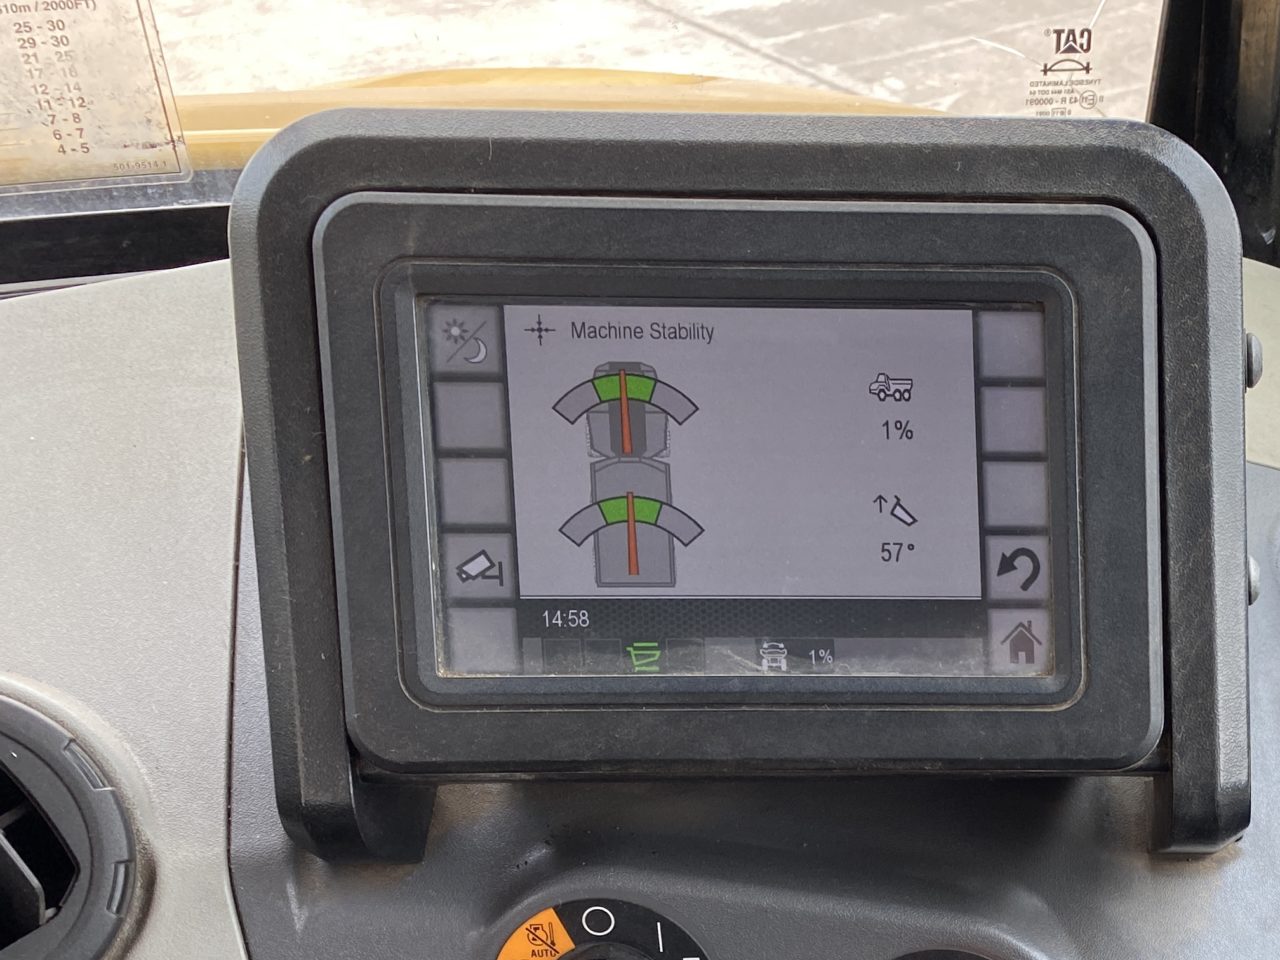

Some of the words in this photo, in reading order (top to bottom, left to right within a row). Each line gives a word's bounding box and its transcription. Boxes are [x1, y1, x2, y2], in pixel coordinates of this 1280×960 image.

[13, 21, 33, 34] 25
[46, 19, 66, 32] 30
[17, 37, 37, 50] 29
[50, 35, 70, 48] 30
[22, 52, 40, 65] 21
[55, 50, 75, 62] 25
[31, 83, 49, 95] 12
[65, 81, 82, 93] 14
[35, 99, 53, 111] 11
[69, 96, 87, 109] 12
[47, 113, 57, 126] 7
[71, 112, 82, 124] 8
[52, 128, 63, 141] 6
[75, 127, 84, 139] 7
[57, 143, 67, 155] 4
[80, 142, 91, 154] 5
[570, 321, 644, 340] Machine
[649, 321, 715, 345] Stability
[881, 419, 914, 441] 1%
[880, 542, 916, 563] 57°
[541, 609, 591, 628] 14:58
[807, 649, 834, 666] 1%
